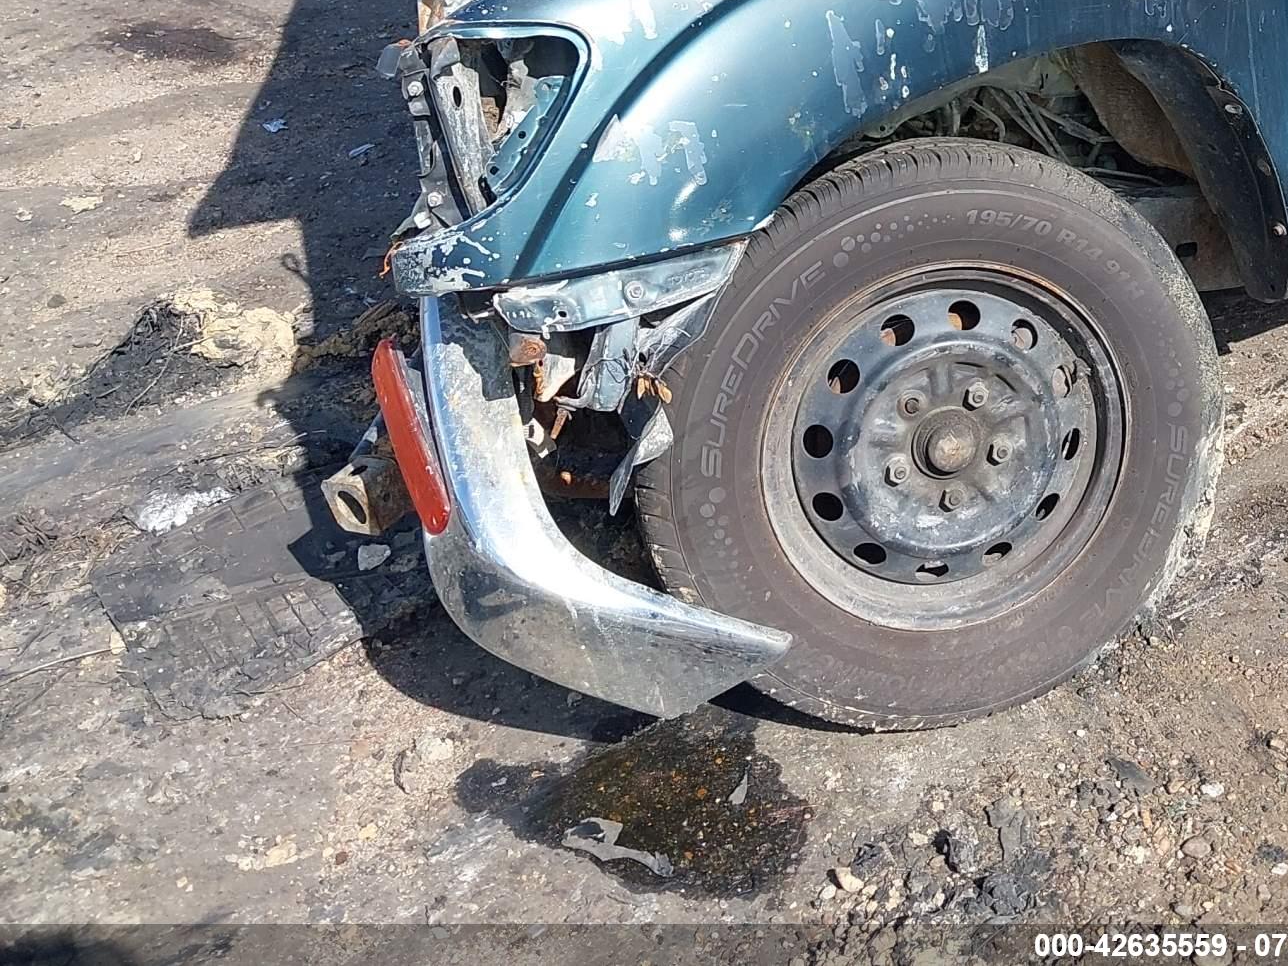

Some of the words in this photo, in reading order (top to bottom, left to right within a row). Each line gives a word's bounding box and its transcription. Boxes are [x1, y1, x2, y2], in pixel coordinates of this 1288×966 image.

[966, 209, 1053, 236] 195/70
[1055, 227, 1103, 261] R14
[701, 260, 826, 478] SUREDRIVE
